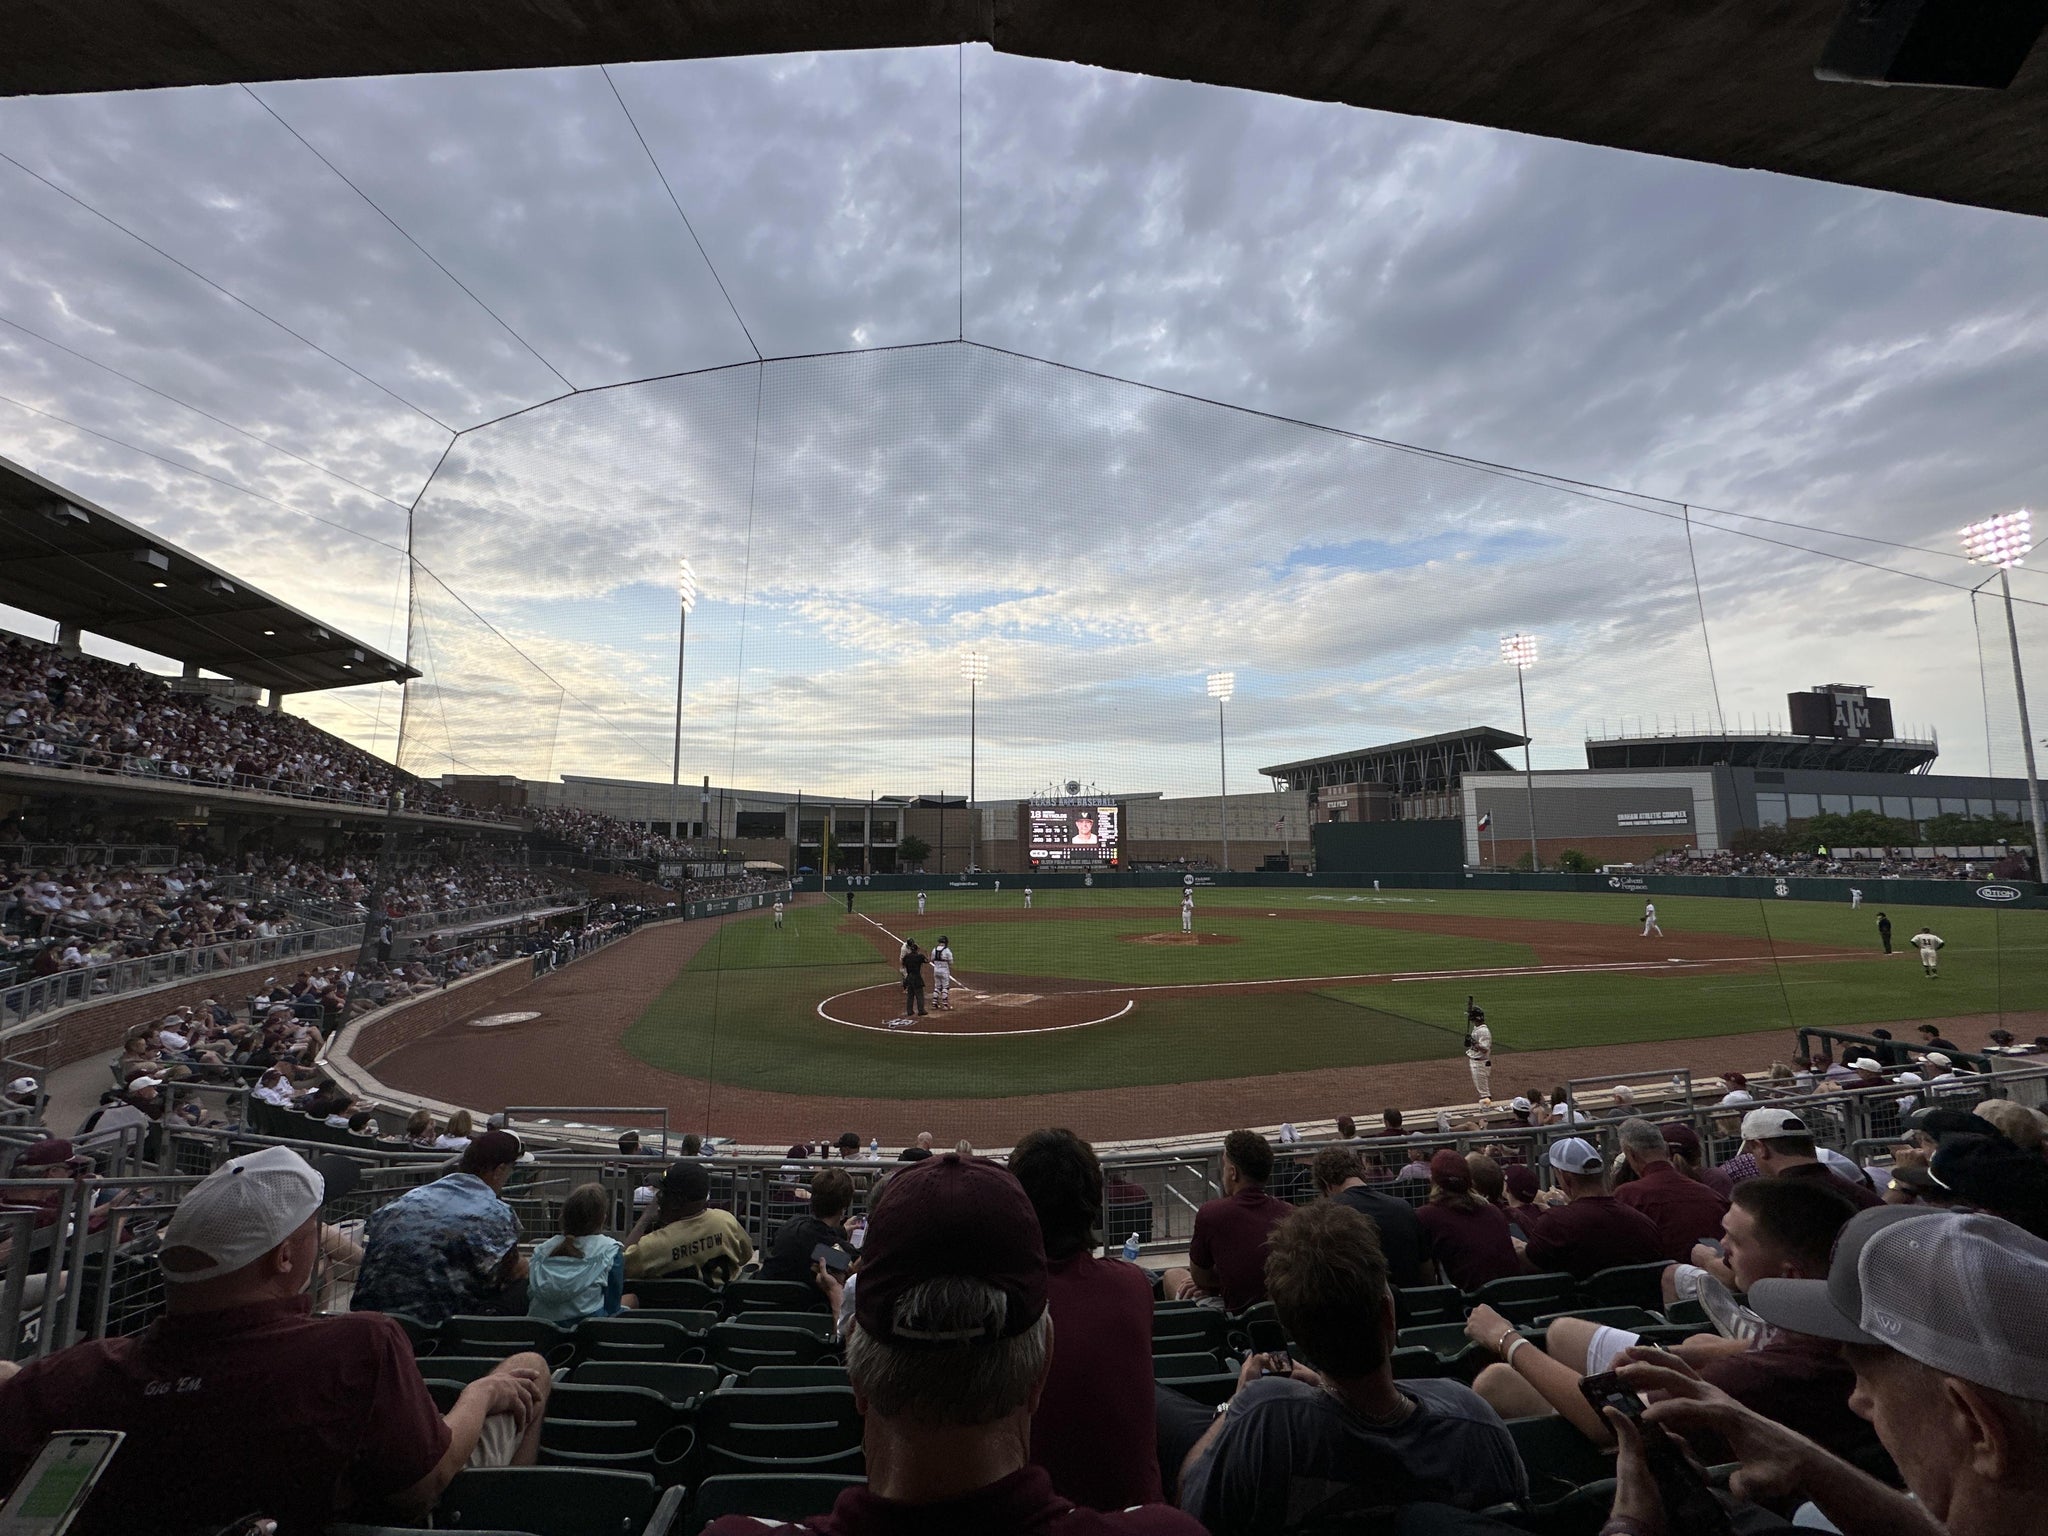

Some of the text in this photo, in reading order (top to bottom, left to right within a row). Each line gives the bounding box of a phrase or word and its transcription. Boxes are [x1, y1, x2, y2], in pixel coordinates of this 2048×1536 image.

[1029, 798, 1057, 806] TEXAS
[1077, 798, 1118, 806] BASEBALL
[1030, 810, 1042, 819] 18
[672, 1232, 723, 1260] BRISTOW
